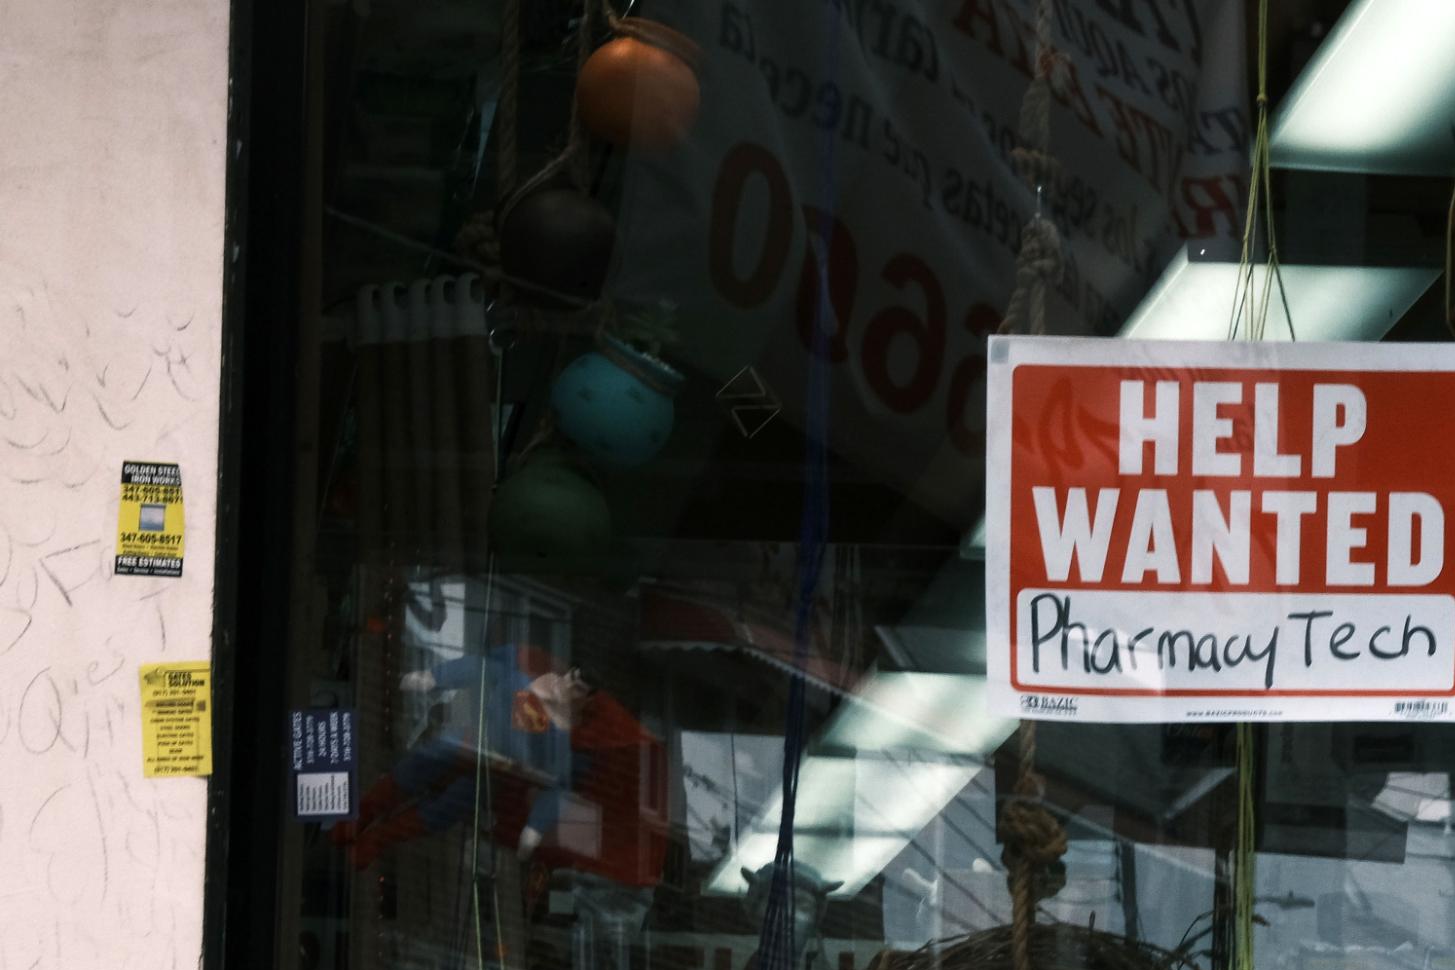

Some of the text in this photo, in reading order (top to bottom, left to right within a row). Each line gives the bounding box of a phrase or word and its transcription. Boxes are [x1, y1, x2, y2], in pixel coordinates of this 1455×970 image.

[1118, 380, 1368, 478] HELP
[118, 557, 137, 567] FREE
[1031, 486, 1446, 587] WANTED
[1030, 593, 1437, 689] Pharmacy Tech
